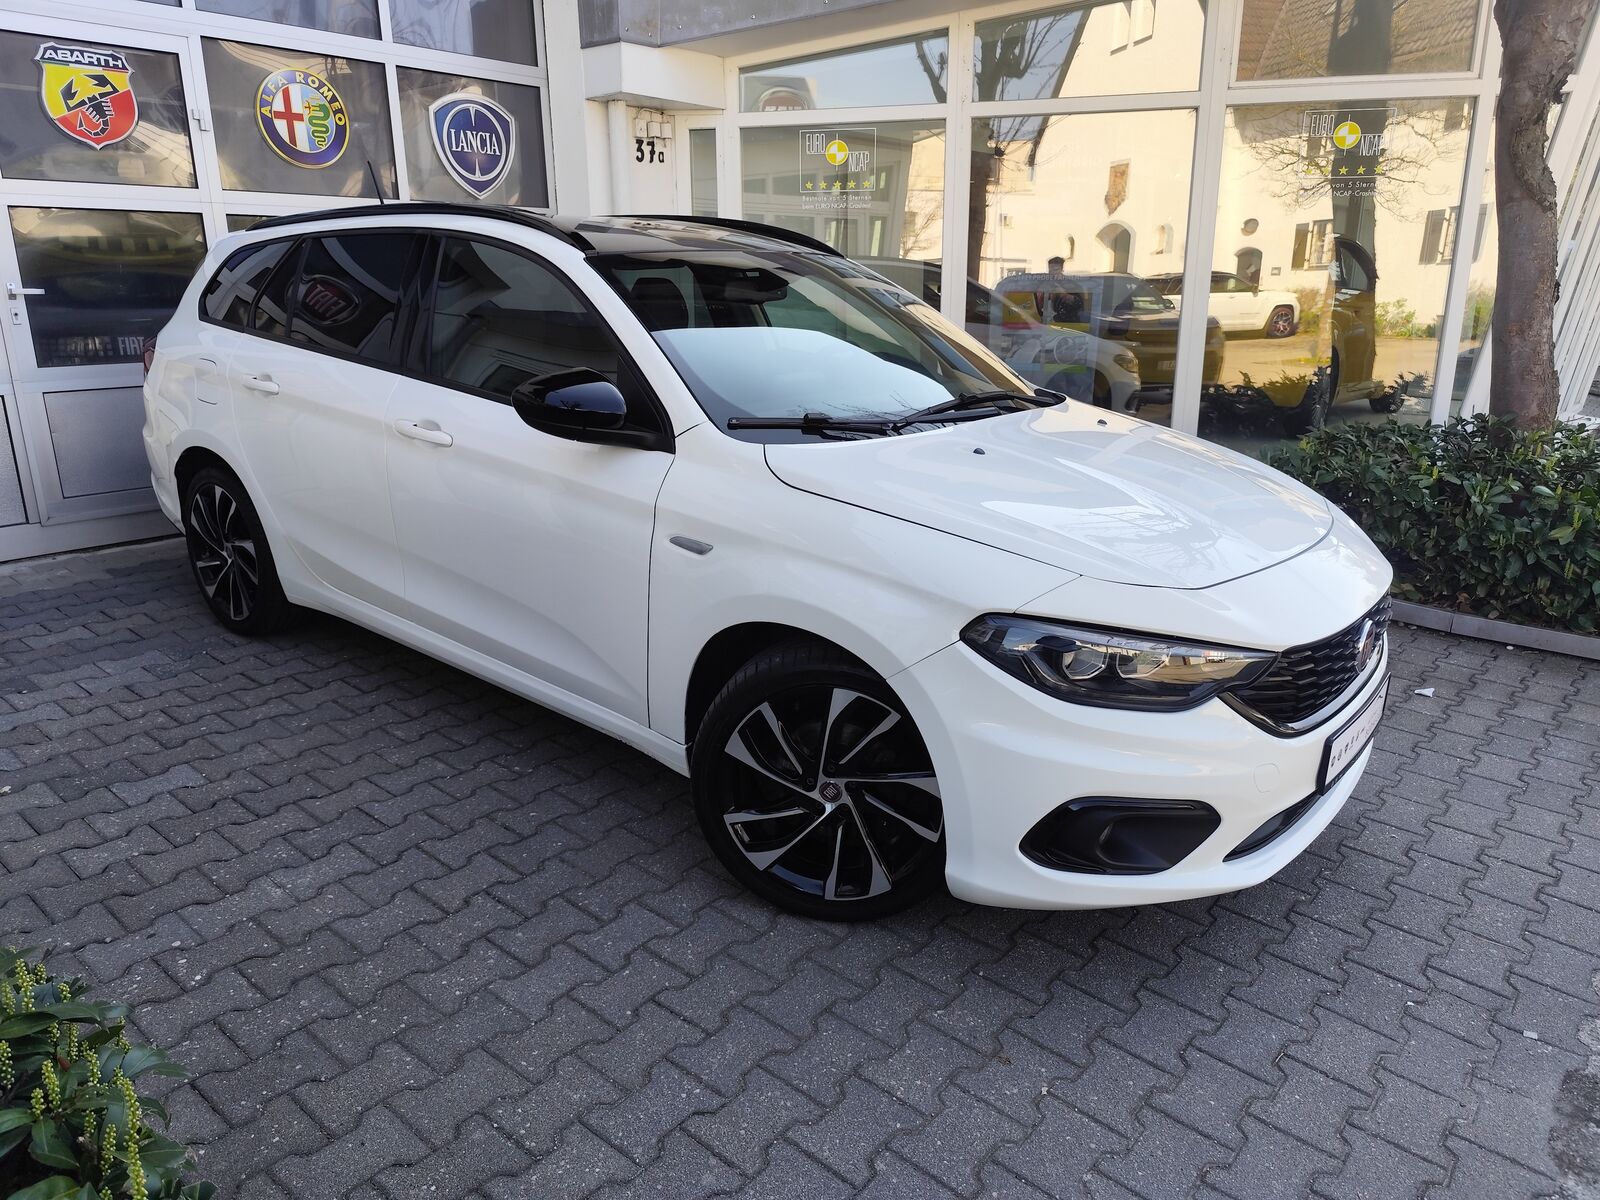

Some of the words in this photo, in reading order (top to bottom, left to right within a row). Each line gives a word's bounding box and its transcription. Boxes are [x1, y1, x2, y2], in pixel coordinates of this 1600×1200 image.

[43, 49, 123, 68] ABARTH
[261, 76, 288, 119] ALFA
[295, 72, 345, 126] ROMEO
[450, 129, 501, 155] LANCIA
[1310, 115, 1334, 135] EURO
[1360, 134, 1384, 156] NCAP
[636, 139, 664, 163] 37a
[806, 133, 825, 153] EURO
[849, 151, 870, 171] NCAP
[117, 336, 145, 356] FIAT
